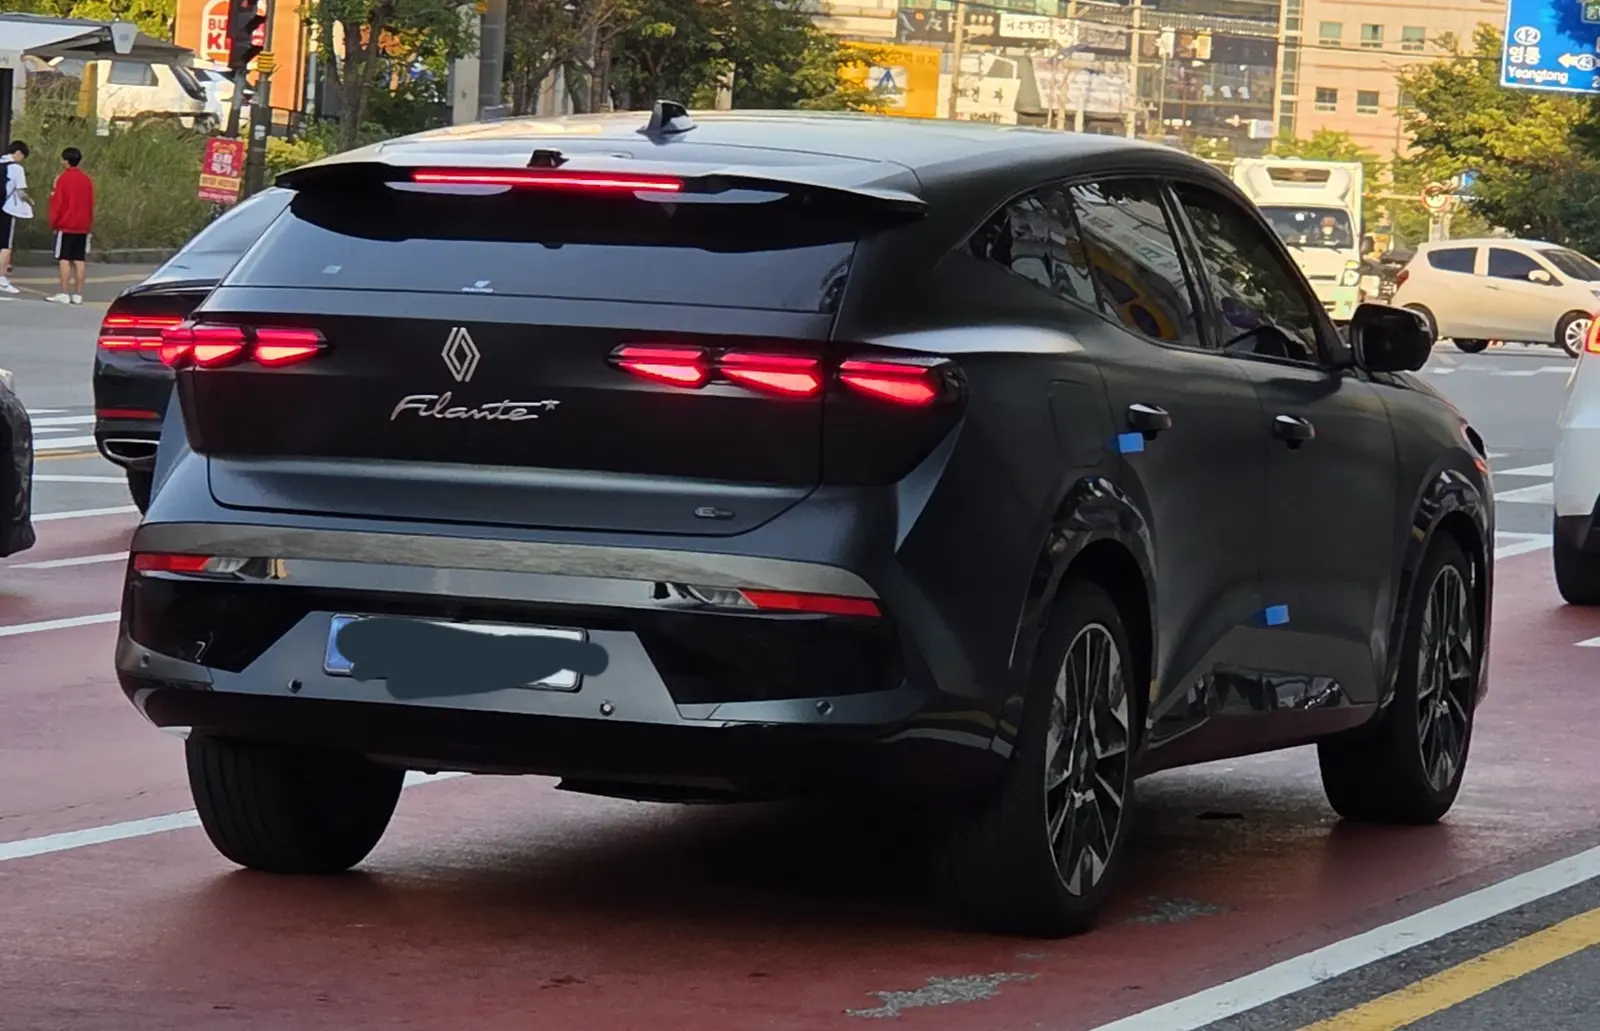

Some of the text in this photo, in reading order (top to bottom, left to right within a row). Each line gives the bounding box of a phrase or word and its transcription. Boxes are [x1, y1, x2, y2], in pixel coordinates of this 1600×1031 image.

[1517, 29, 1539, 42] 42
[1508, 66, 1569, 84] Yeongtong
[390, 391, 542, 421] Filante
